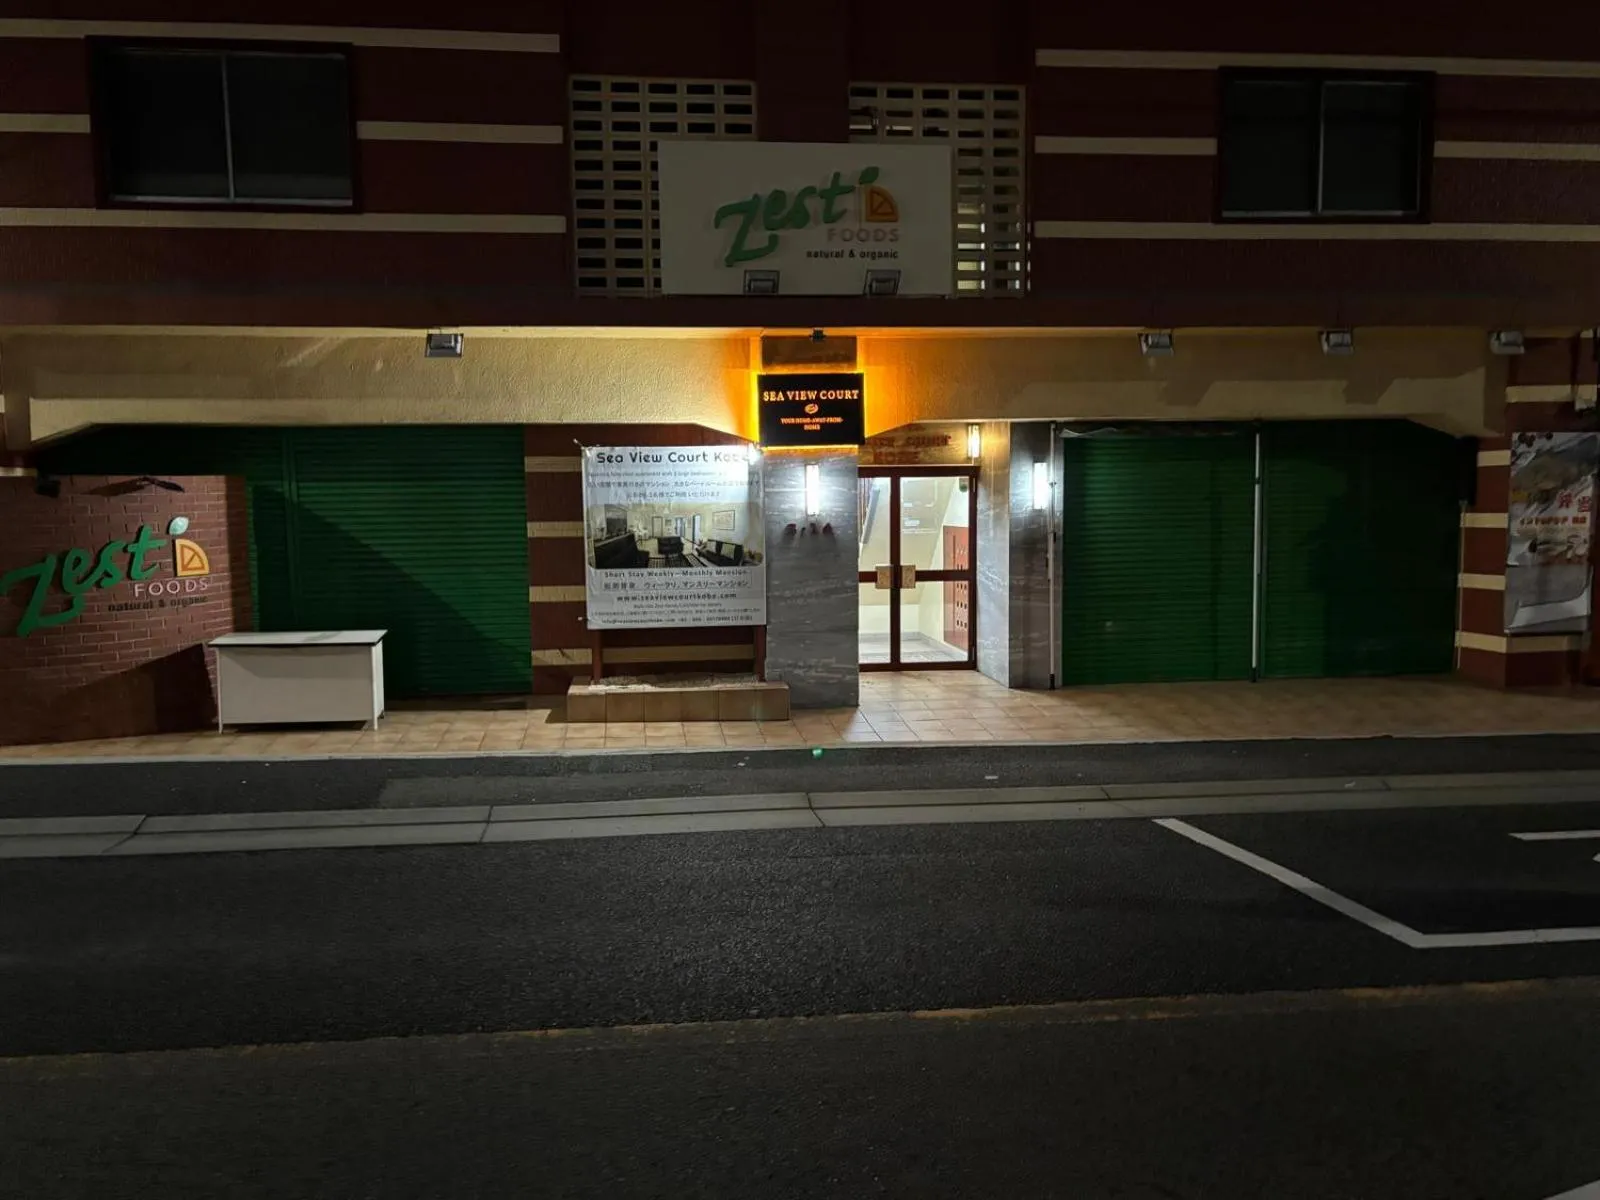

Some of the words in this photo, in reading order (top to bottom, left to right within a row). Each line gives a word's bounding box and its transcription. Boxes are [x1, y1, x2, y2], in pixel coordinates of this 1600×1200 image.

[714, 171, 856, 267] Zest
[827, 228, 899, 242] FOODS
[806, 249, 844, 259] natural
[848, 249, 856, 258] &
[859, 249, 899, 260] organic
[763, 390, 785, 402] SEA
[787, 389, 818, 401] VIEW
[819, 389, 860, 400] COURT
[596, 451, 624, 464] Sea
[629, 451, 662, 464] View
[667, 451, 709, 463] Court
[0, 524, 167, 639] Zest
[134, 578, 209, 597] FOODS
[108, 600, 152, 612] natural
